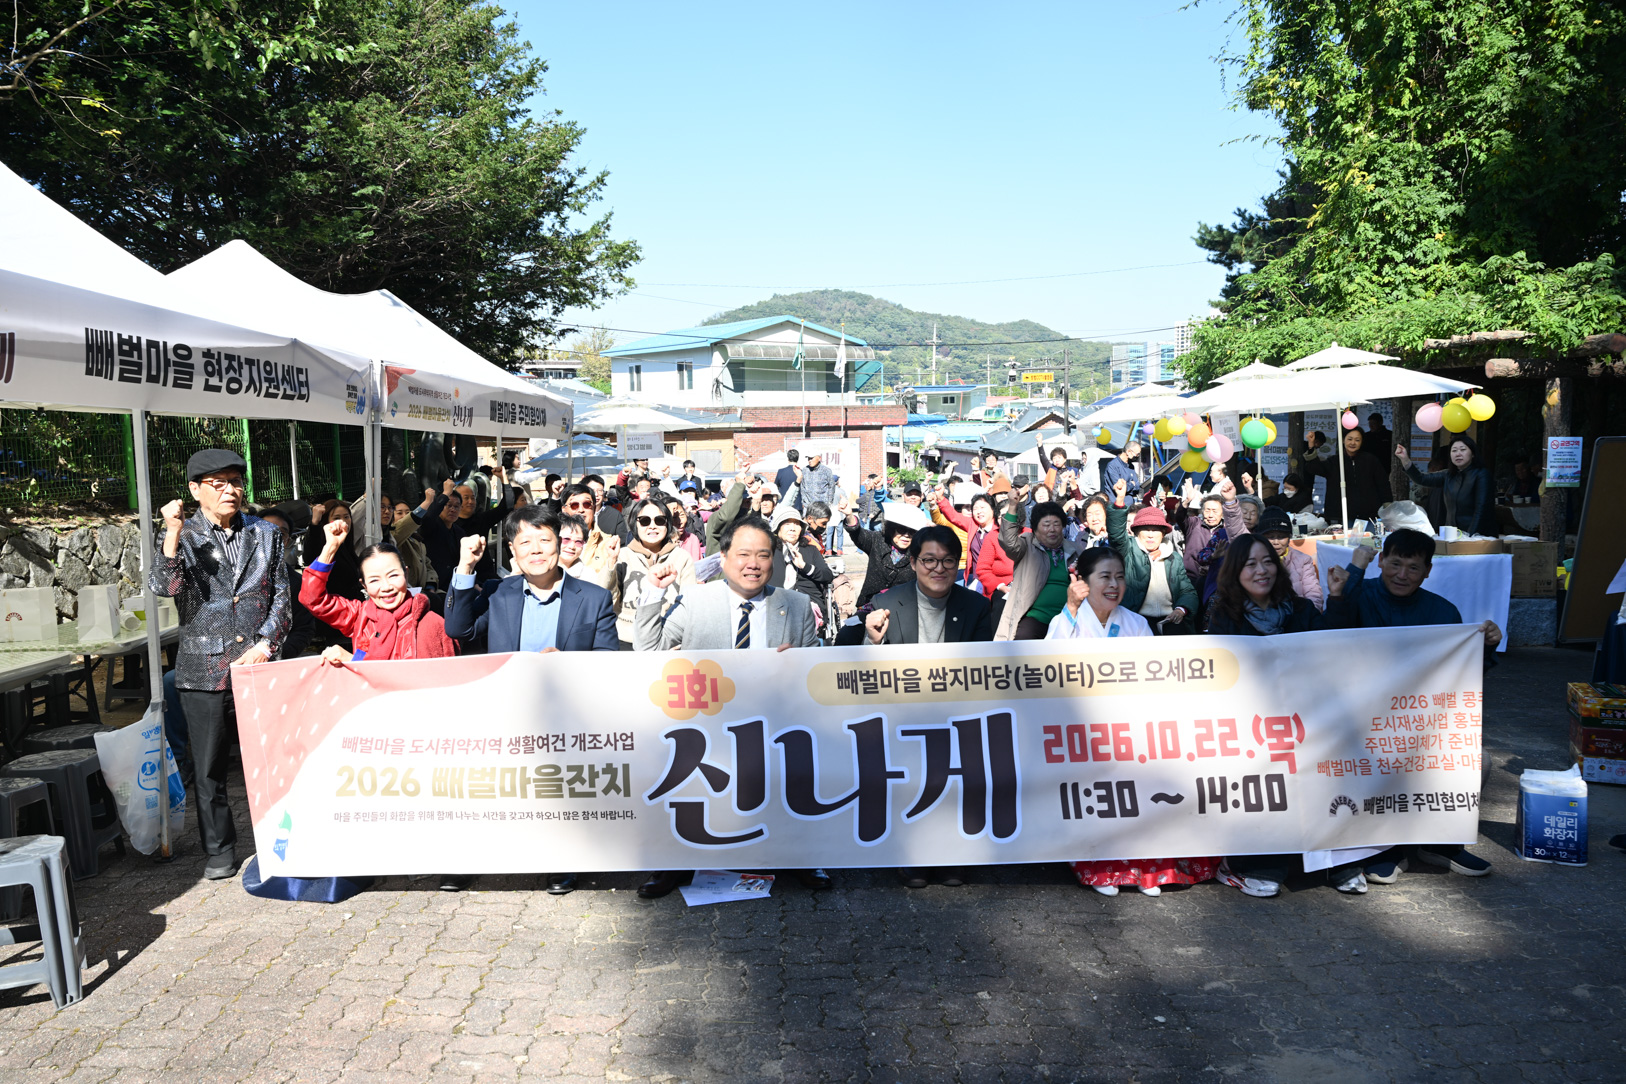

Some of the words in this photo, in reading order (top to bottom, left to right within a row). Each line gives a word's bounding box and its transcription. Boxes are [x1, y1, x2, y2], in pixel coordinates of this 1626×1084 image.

[85, 327, 194, 389] 빼벌마을
[202, 348, 310, 402] 현장지원센터
[453, 405, 473, 428] 신나게
[490, 400, 517, 424] 빼벌마을
[518, 404, 547, 427] 주민협의체
[836, 668, 922, 696] 빼벌마을
[927, 661, 1138, 695] 쌈지마당(놀이터)으로
[1145, 658, 1214, 683] 오세요!
[667, 668, 719, 710] 3회
[1391, 694, 1428, 710] 2026
[1432, 691, 1457, 709] 빼벌
[1371, 712, 1448, 732] 도시재생사업
[341, 736, 406, 755] 빼벌마을
[408, 736, 503, 755] 도시취약지역
[507, 733, 566, 755] 생활여건
[571, 731, 635, 753] 개조사업
[1042, 712, 1306, 774] 2026.10.22.(목)
[1365, 733, 1443, 754] 주민협의체가
[1448, 732, 1482, 750] 준비
[646, 710, 1018, 847] 신나게
[1317, 758, 1372, 777] 빼벌마을
[335, 765, 421, 798] 2026
[432, 763, 631, 800] 빼벌마을잔치
[1059, 780, 1140, 820] 11:30
[1196, 773, 1288, 814] 14:00
[1363, 792, 1409, 815] 빼벌마을
[334, 811, 351, 823] 마을
[353, 811, 387, 823] 주민들의
[390, 811, 415, 822] 화합을
[418, 810, 435, 822] 위해
[437, 810, 453, 822] 함께
[455, 811, 480, 821] 나누는
[482, 811, 507, 821] 시간을
[509, 811, 534, 821] 갖고자
[536, 811, 561, 821] 하오니
[563, 810, 580, 821] 많은
[581, 810, 598, 821] 참석
[600, 809, 637, 821] 바랍니다.
[1543, 815, 1578, 829] 데일리
[1543, 827, 1578, 841] 화장지
